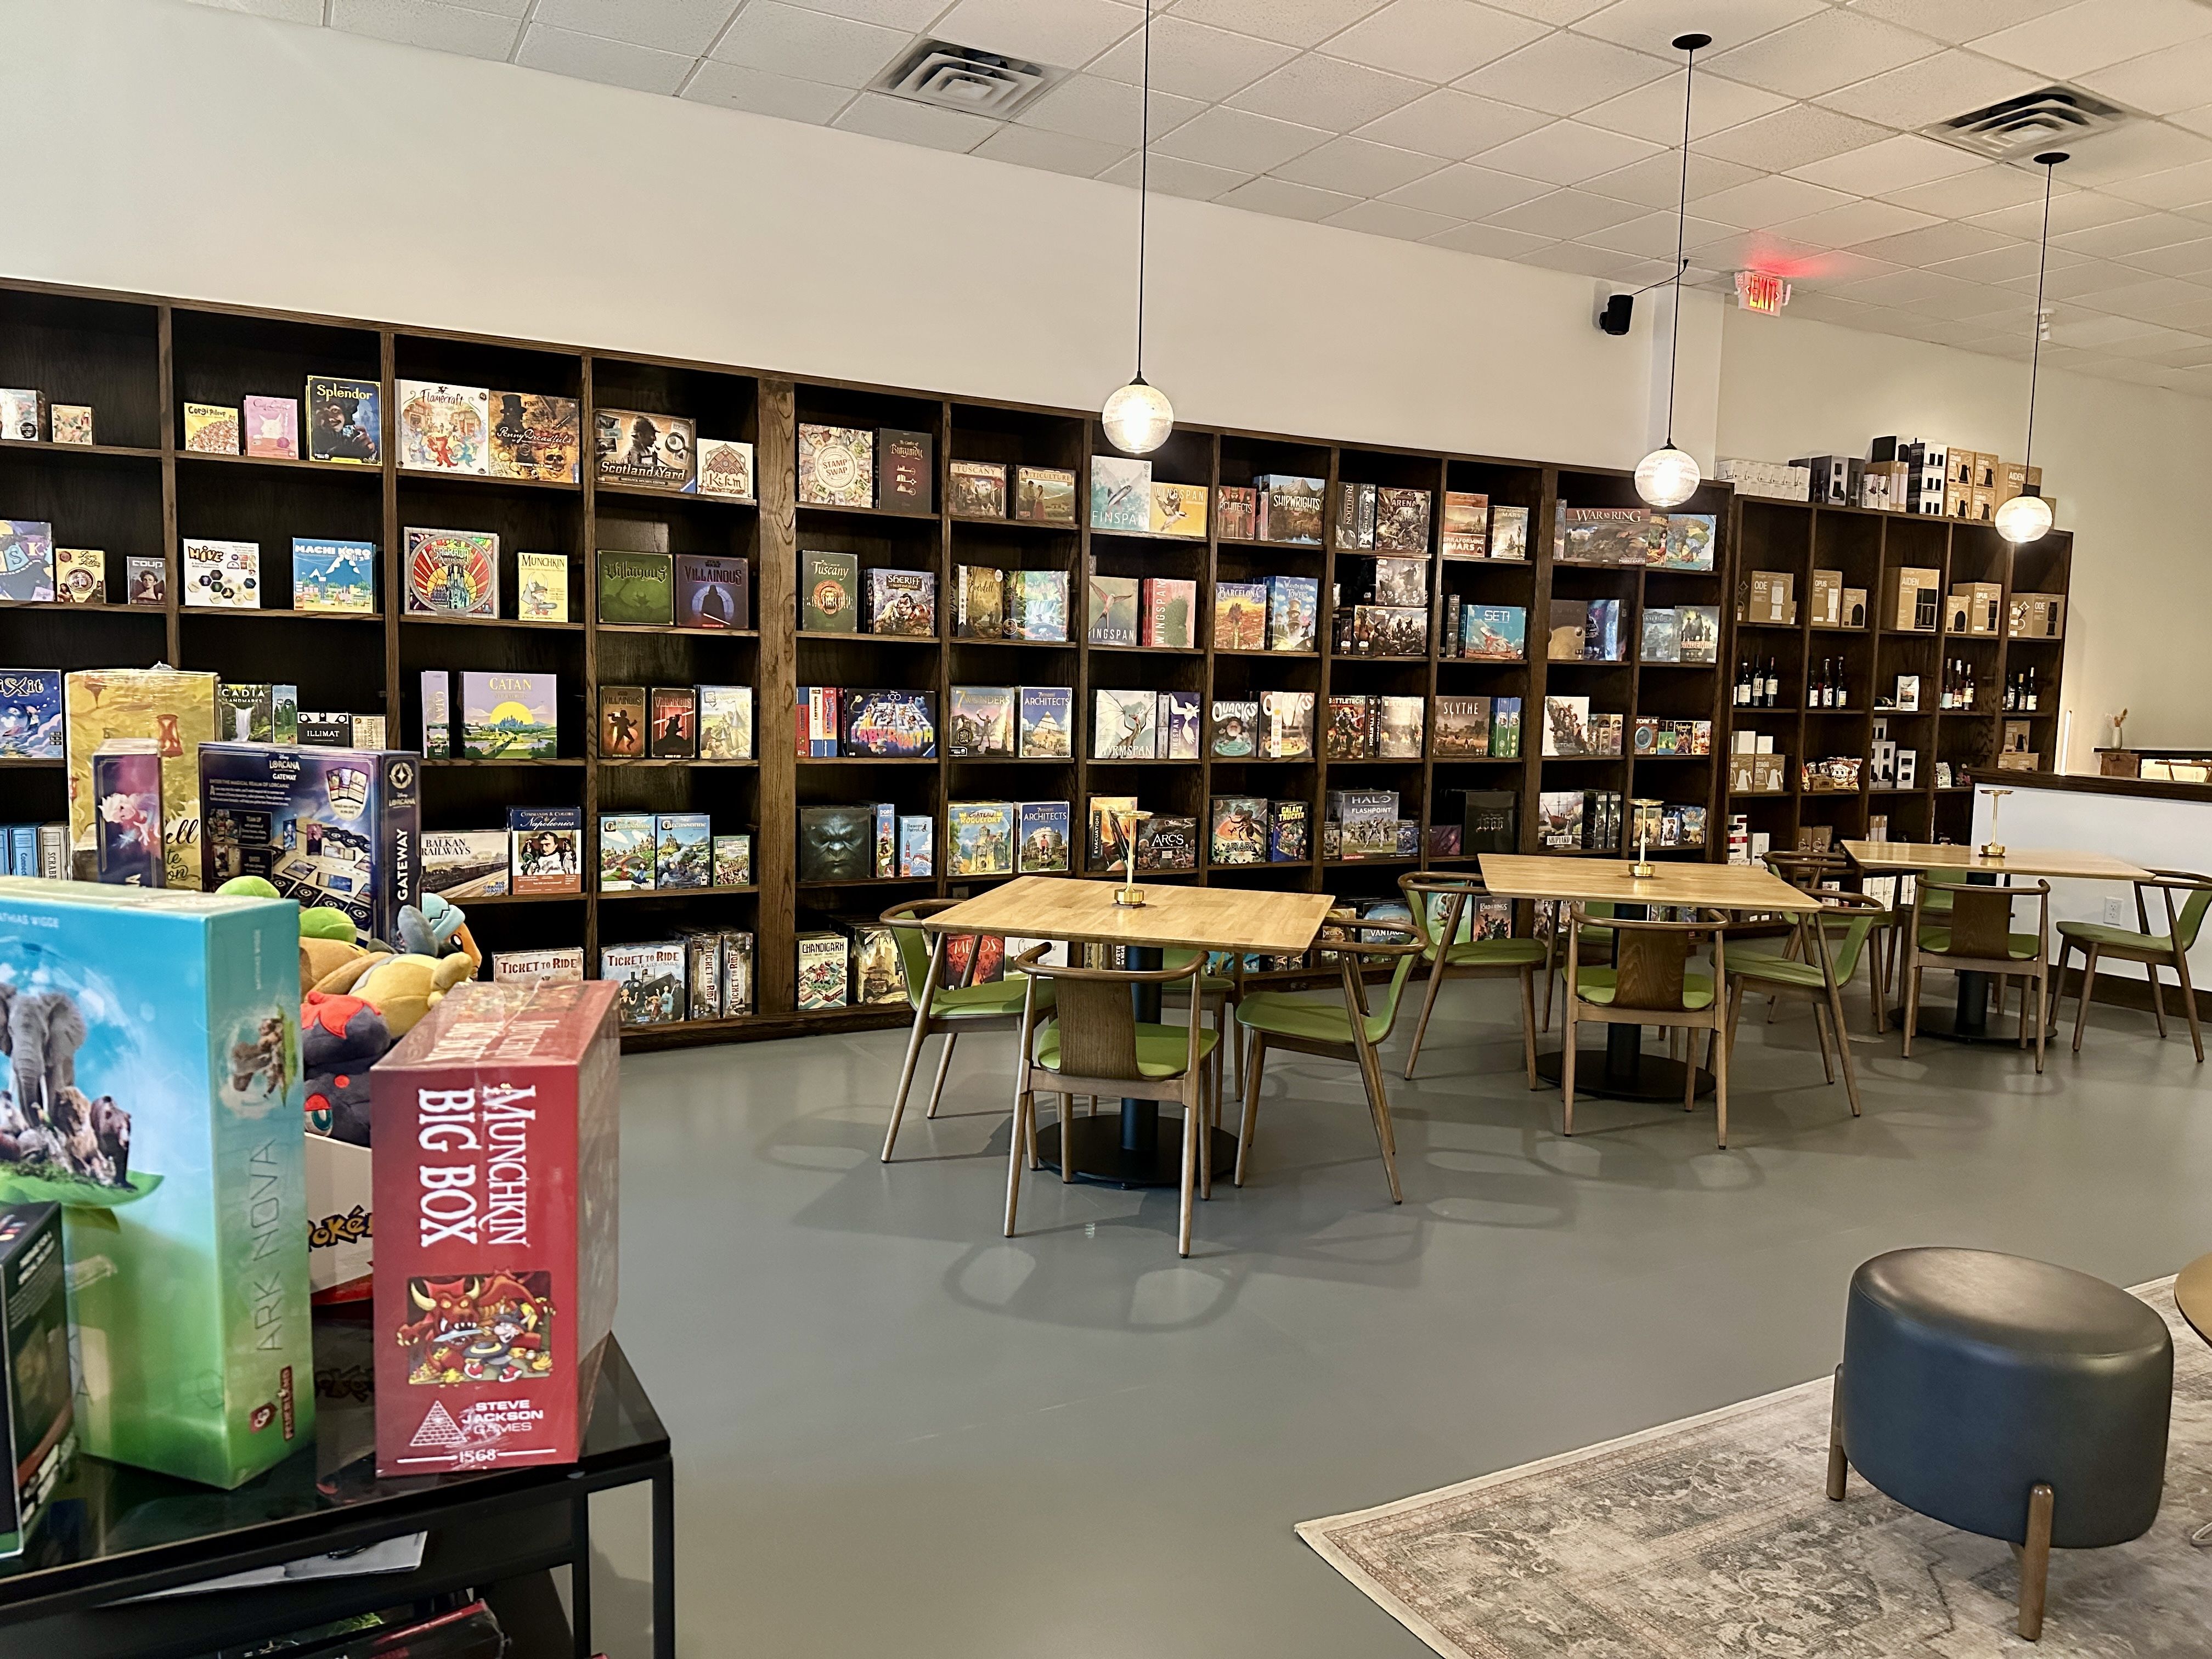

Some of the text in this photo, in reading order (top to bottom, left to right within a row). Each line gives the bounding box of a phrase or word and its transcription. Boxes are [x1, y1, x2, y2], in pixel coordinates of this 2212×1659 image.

[1749, 275, 1778, 312] EXIT
[317, 383, 373, 401] Splendor
[420, 389, 464, 405] Flamecraft
[188, 405, 208, 416] Corgi
[496, 427, 571, 447] Penny Dreadfuls
[890, 443, 923, 460] Burgundy
[601, 461, 685, 480] Scotland Yard
[822, 459, 848, 469] STAMP
[957, 466, 996, 475] TUSCANY
[826, 467, 848, 476] SWAP
[1023, 470, 1071, 481] VITICULTURE
[2008, 472, 2025, 482] AIDEN
[709, 472, 741, 488] Kilim
[1154, 487, 1204, 501] WINGSPAN
[1273, 494, 1321, 511] SHIPWRIGHTS
[1346, 484, 1354, 525] REBELLION
[1391, 499, 1416, 507] ARENA
[1092, 511, 1146, 526] FINSPAN
[1576, 510, 1603, 521] WAR
[1613, 510, 1641, 522] RING
[295, 545, 371, 556] MACHI KORO
[433, 546, 470, 560] SAGRADA
[1450, 543, 1475, 551] MARS
[521, 555, 565, 567] MUNCHKIN
[603, 561, 668, 583] Villainous
[684, 566, 742, 586] VILLAINOUS
[811, 560, 849, 580] Tuscany
[888, 575, 922, 585] SHERIFF
[968, 580, 995, 593] Everdell
[1754, 580, 1768, 590] ODE
[1901, 576, 1919, 586] AIDEN
[1218, 587, 1259, 599] BARCELONA
[1286, 589, 1308, 598] TOWERS
[1155, 579, 1167, 645] WINGSPAN
[2035, 601, 2045, 611] ODE
[1485, 610, 1510, 621] SETI
[1681, 640, 1713, 649] ANDEMIC
[489, 678, 532, 690] CATAN
[221, 688, 265, 697] CADIA
[956, 690, 1011, 708] 7 WONDERS
[436, 691, 445, 720] CATAN
[1024, 697, 1069, 706] ARCHITECTS
[1263, 694, 1313, 716] QACKS
[1212, 702, 1258, 723] QUACKS
[1443, 702, 1479, 719] SCYTHE
[366, 718, 375, 750] Innovati
[851, 726, 934, 748] LABYRINTH
[1171, 719, 1180, 756] WINGSPAN
[1098, 746, 1152, 757] WYRMSPAN
[269, 760, 300, 771] LORCANA
[1351, 795, 1392, 804] HALO
[1024, 812, 1067, 821] ARCHITECTS
[1281, 805, 1304, 814] GALAXY
[520, 817, 574, 830] Napoleonics
[960, 816, 1002, 824] ROQUEFORT
[1278, 812, 1305, 822] TRUCKER
[605, 821, 652, 832] Carcassonne
[661, 820, 707, 830] Carcassonne
[426, 838, 466, 848] BALKAN
[1151, 833, 1184, 847] ARCS
[1224, 842, 1256, 851] APIARY
[1548, 836, 1571, 844] SHIPYARD
[421, 847, 471, 856] RAILWAYS
[48, 851, 57, 881] SCRABB
[397, 829, 408, 901] GATEWAY
[802, 941, 844, 953] CHANDIGARH
[953, 938, 996, 955] MEOS
[501, 961, 539, 973] TICKET
[553, 958, 577, 969] RIDE
[607, 953, 643, 966] TICKET
[656, 951, 680, 962] RIDE
[705, 948, 714, 976] TICKET
[729, 950, 738, 969] RIDE
[706, 985, 715, 1003] RIDE
[730, 978, 738, 1006] TICKET
[417, 1087, 481, 1248] BIG BOX
[481, 1085, 537, 1248] MUNCHKIN
[250, 1138, 284, 1352] ARK NOVA
[475, 1398, 531, 1412] STEVE
[461, 1408, 544, 1423] JACKSON
[473, 1420, 533, 1434] GAMES
